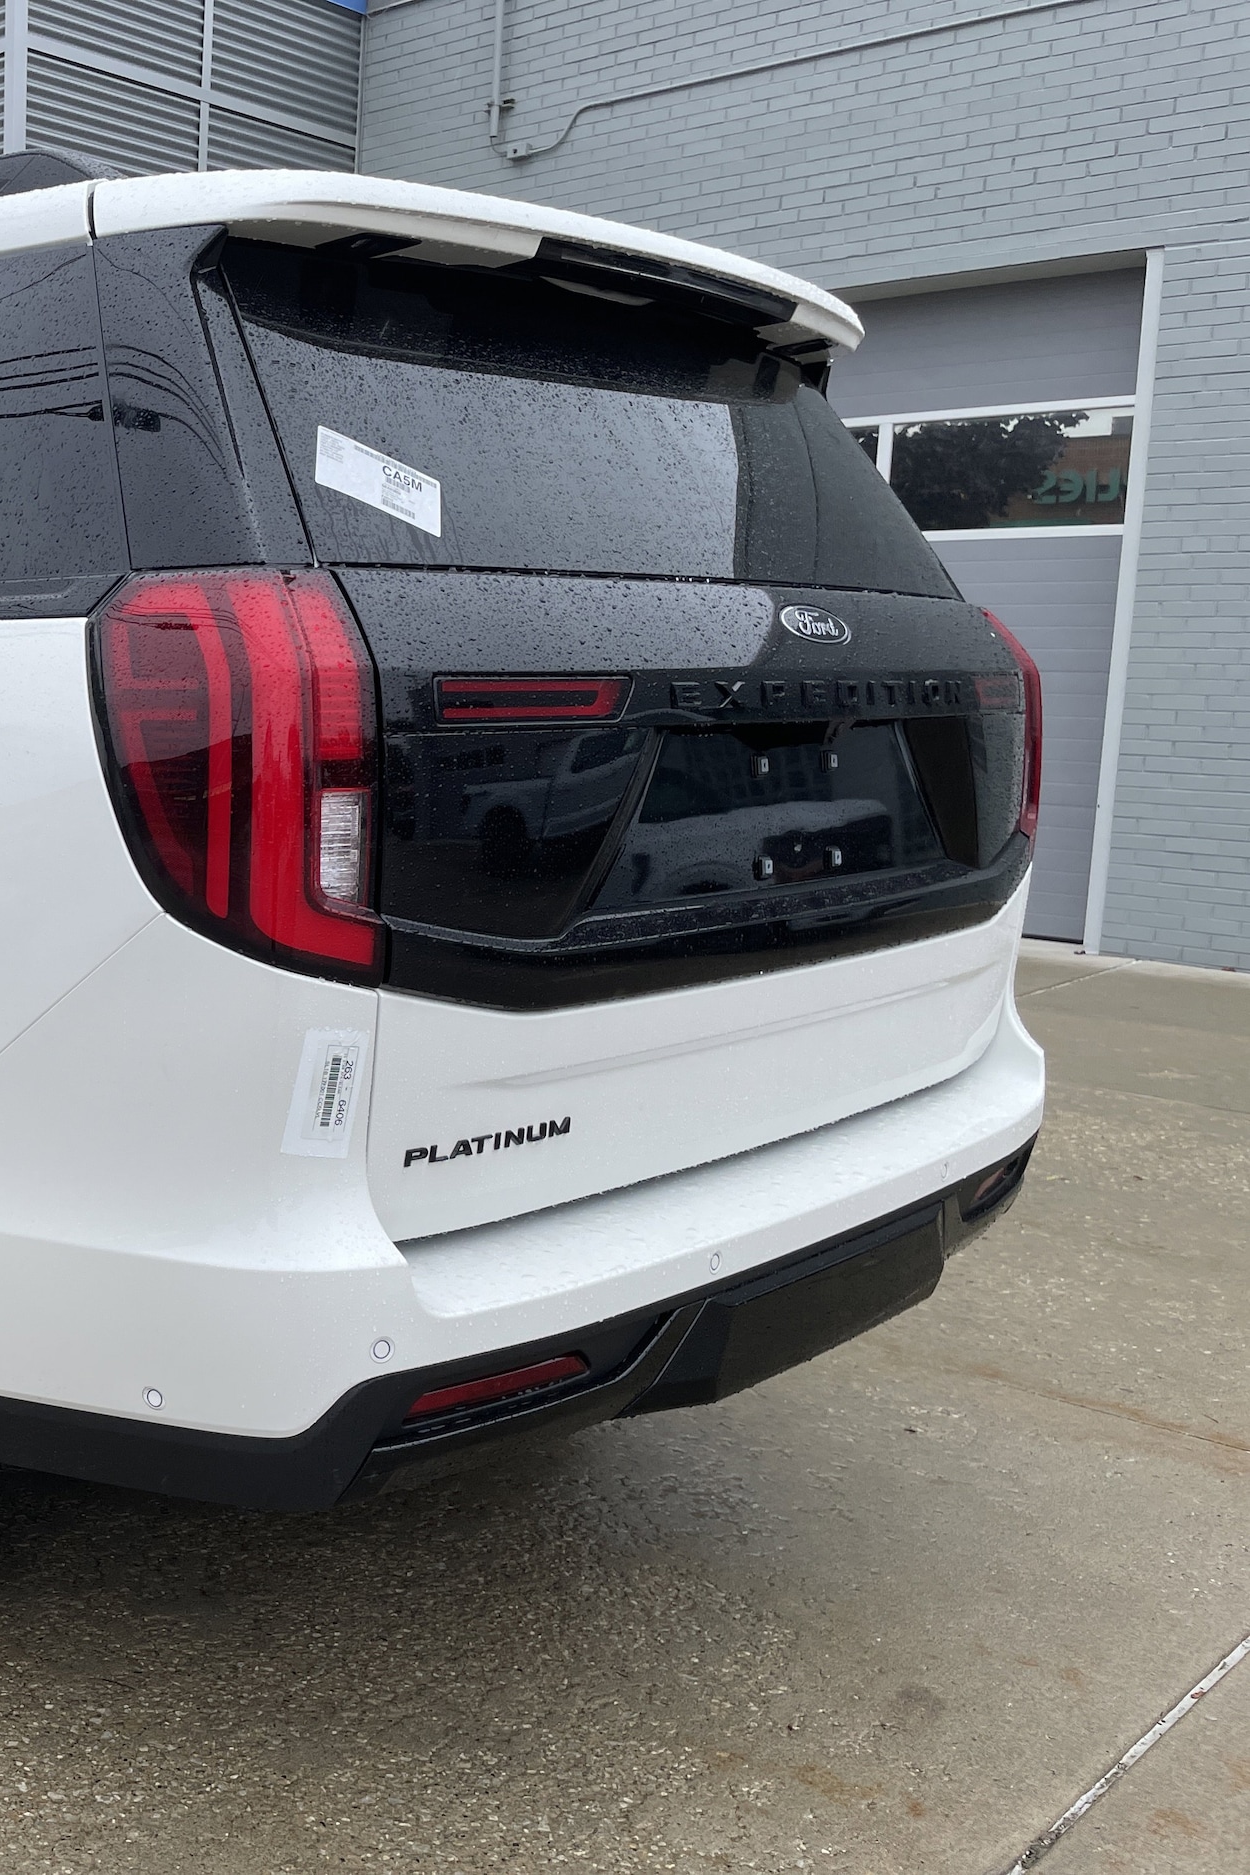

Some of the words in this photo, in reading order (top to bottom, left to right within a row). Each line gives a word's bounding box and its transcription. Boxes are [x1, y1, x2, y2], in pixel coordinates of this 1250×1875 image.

[382, 465, 422, 493] CA5M
[668, 679, 963, 710] EXPEDITION
[343, 1060, 354, 1080] 263
[334, 1099, 347, 1126] 6406
[403, 1116, 571, 1168] PLATINUM
